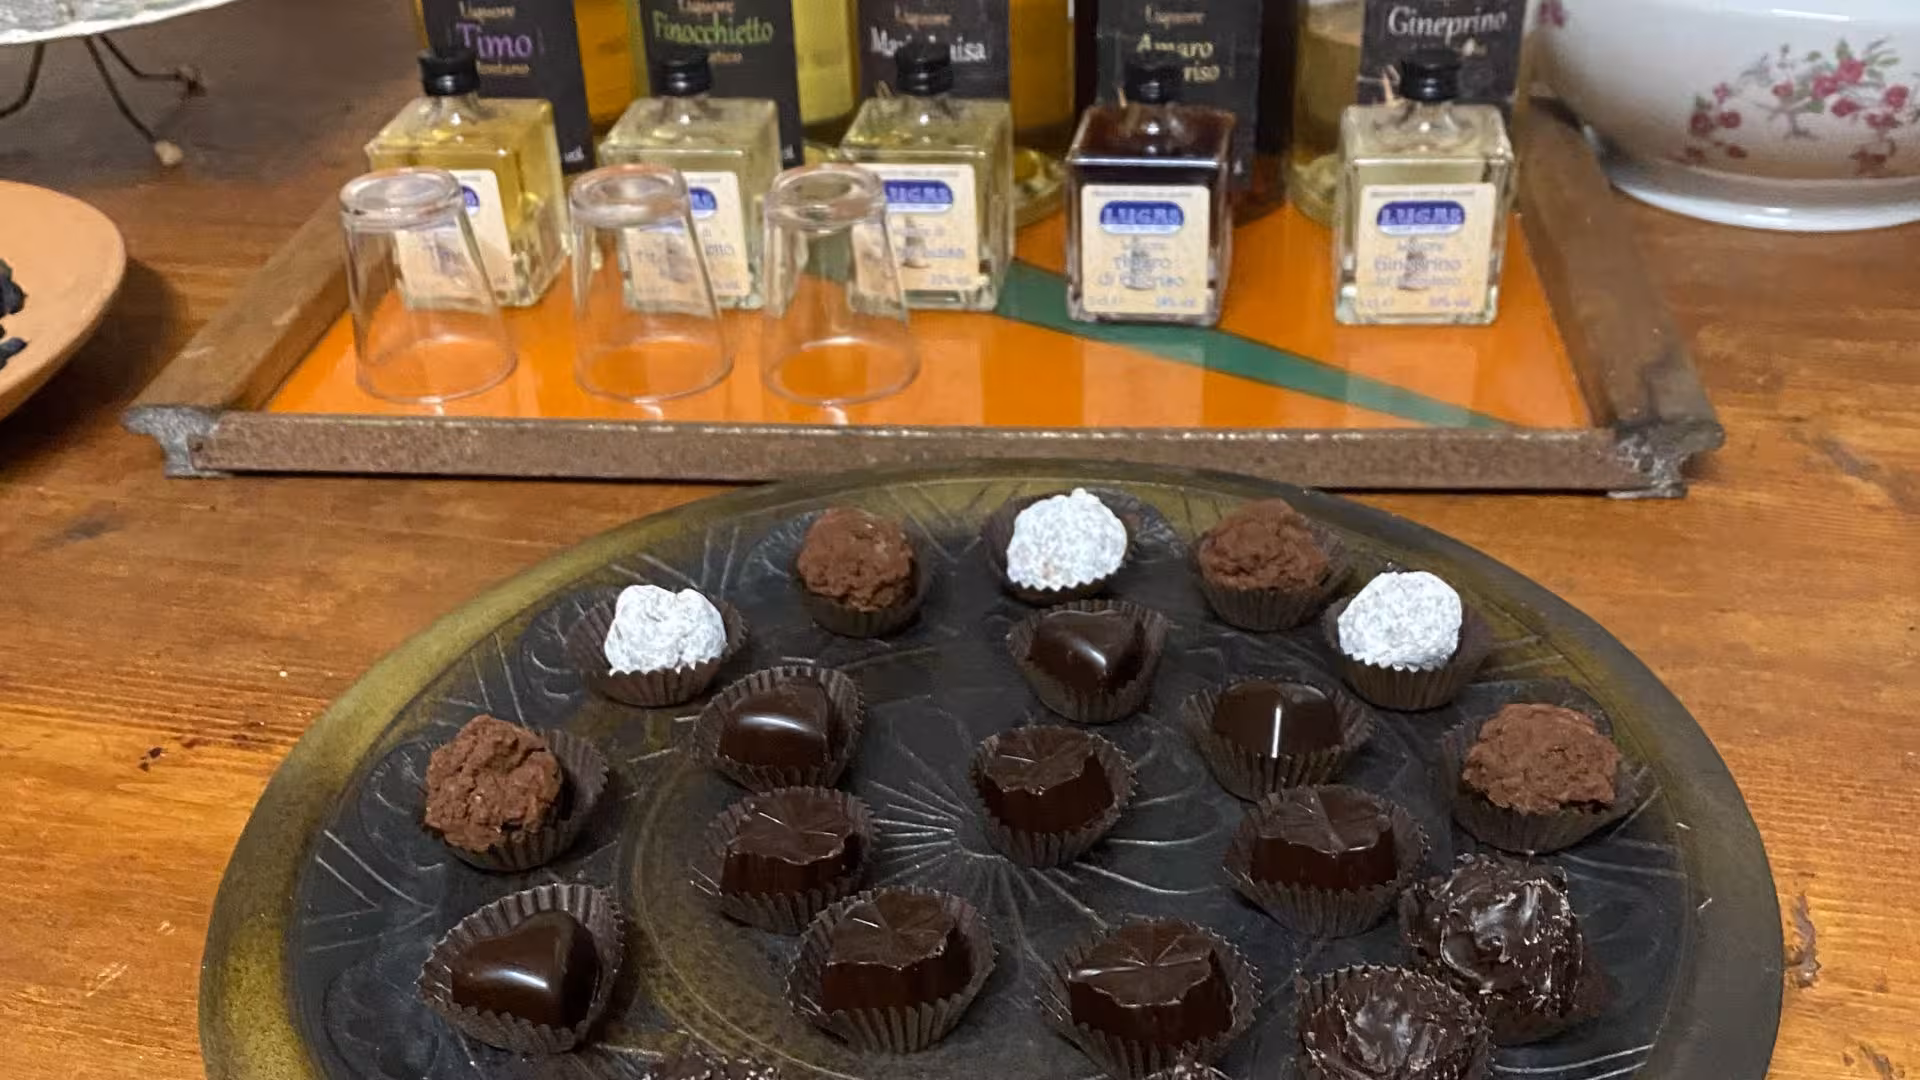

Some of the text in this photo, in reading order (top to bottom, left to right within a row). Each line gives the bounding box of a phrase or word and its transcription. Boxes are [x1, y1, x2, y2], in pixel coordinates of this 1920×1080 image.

[456, 21, 533, 58] Timo
[653, 11, 774, 44] Finocchietto
[1388, 6, 1507, 45] Gineprino
